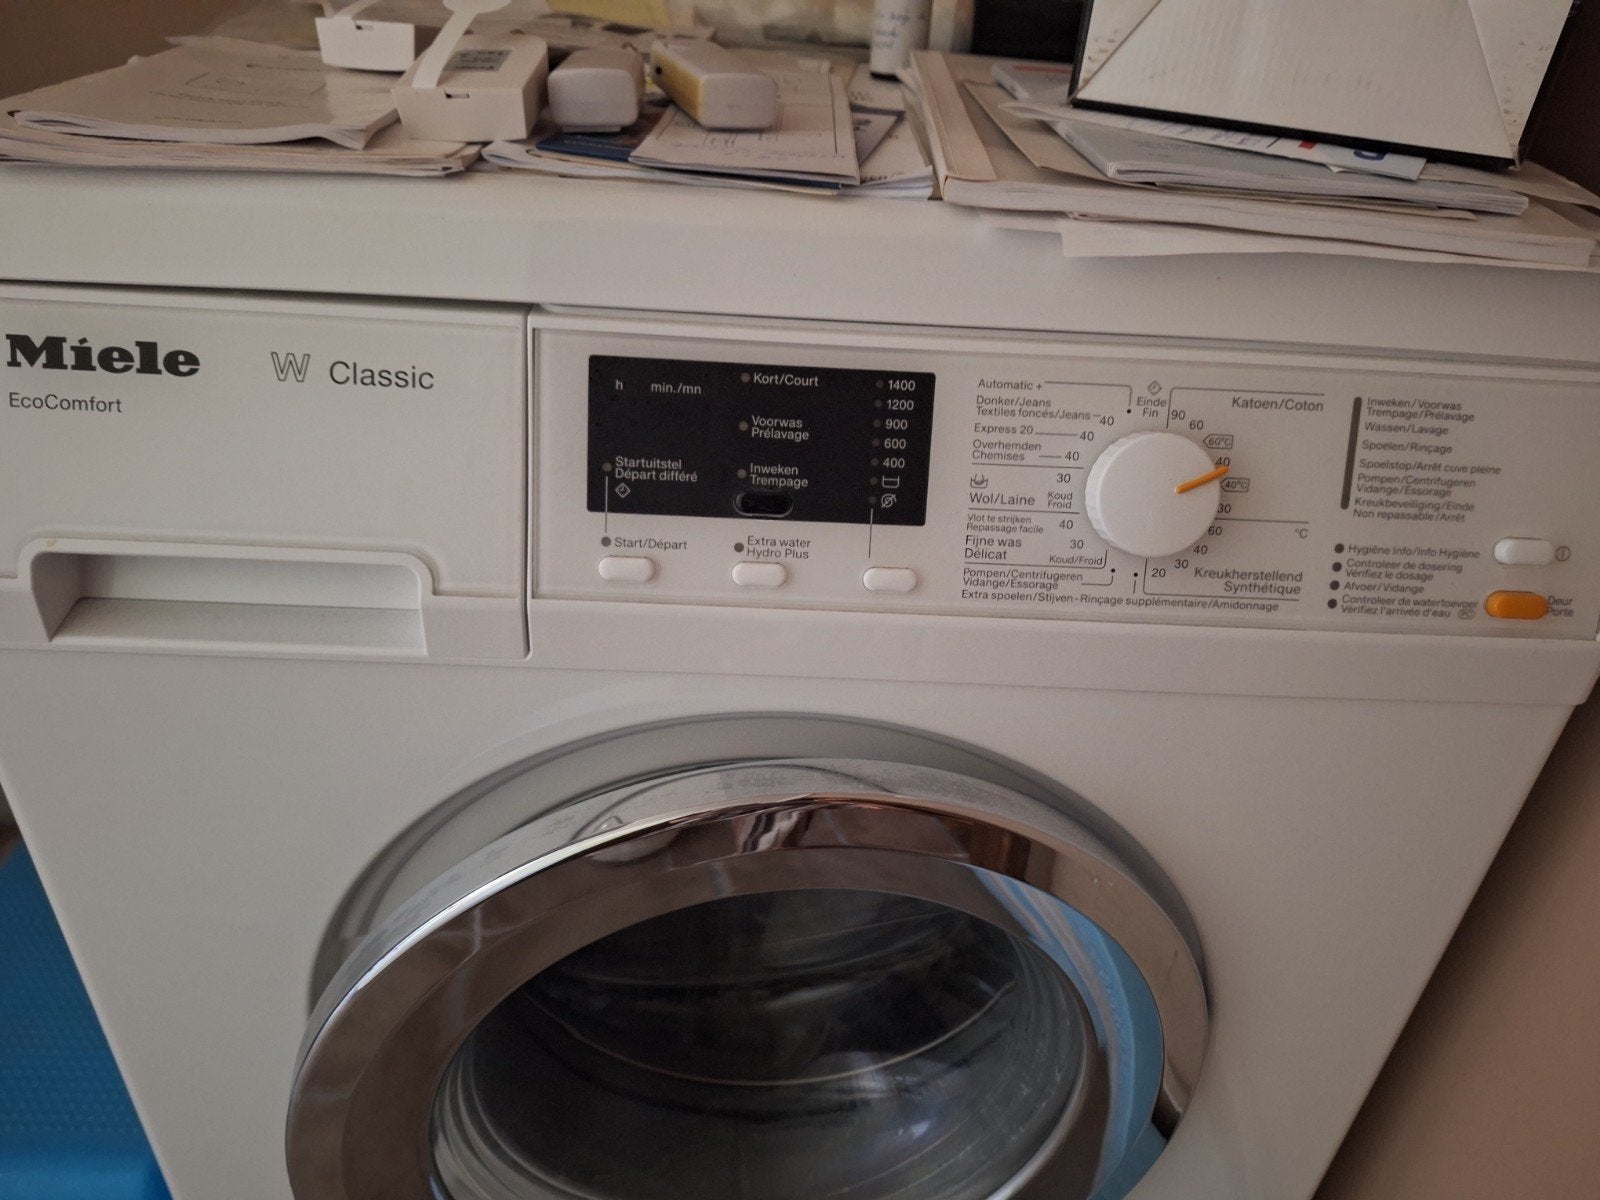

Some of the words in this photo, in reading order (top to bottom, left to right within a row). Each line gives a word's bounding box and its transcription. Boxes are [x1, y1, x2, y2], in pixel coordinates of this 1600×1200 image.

[6, 334, 200, 377] Miele
[271, 351, 311, 383] W
[329, 360, 434, 390] Classic
[615, 379, 624, 391] h
[753, 373, 819, 387] Kort/Court
[887, 379, 916, 392] 1400
[978, 379, 1033, 391] Automatic
[651, 383, 702, 395] min./mn
[9, 392, 122, 413] EcoComfort
[886, 399, 914, 411] 1200
[976, 395, 1052, 408] Donker/Jeans
[1136, 396, 1167, 408] Einde
[1231, 396, 1325, 413] Katoen/Coton
[1367, 397, 1463, 411] Inweken/Voorwas
[976, 406, 1016, 417] Textiles
[1018, 408, 1091, 421] foncés/Jeans
[1142, 407, 1159, 418] Fin
[1171, 409, 1186, 420] 90
[1367, 407, 1475, 423] Trempage/Prélavage
[751, 415, 803, 428] Voorwas
[885, 419, 908, 430] 900
[1099, 415, 1115, 427] 40
[1189, 420, 1204, 431] 60
[751, 427, 810, 443] Prélavage
[974, 423, 1017, 435] Express
[1020, 425, 1034, 435] 20
[1365, 421, 1449, 436] Wassen/Lavage
[1079, 431, 1095, 442] 40
[884, 438, 906, 450] 600
[972, 439, 1042, 452] Overhemden
[1362, 440, 1453, 455] Spoelen/Rinçage
[972, 450, 1025, 461] Chemises
[1064, 451, 1080, 462] 40
[1215, 456, 1231, 467] 40
[615, 456, 682, 470] Startuitstel
[750, 462, 799, 476] Inweken
[882, 457, 905, 469] 400
[1359, 459, 1442, 472] Spoelstop/Arrêt
[1444, 464, 1469, 473] cuve
[1470, 465, 1501, 476] pleine
[615, 468, 656, 482] Départ
[659, 471, 698, 483] différé
[751, 475, 809, 489] Trempage
[1056, 473, 1071, 484] 30
[1357, 473, 1476, 488] Pompen/Centrifugeren
[1047, 491, 1073, 501] Koud
[1356, 484, 1452, 498] Vidange/Essorage
[969, 492, 1036, 506] Wol/Laine
[1047, 500, 1072, 509] Froid
[1217, 503, 1231, 514] 30
[1353, 509, 1374, 518] Non
[967, 513, 985, 522] Vlot
[987, 514, 996, 522] te
[997, 515, 1032, 524] strijken
[1059, 519, 1074, 530] 40
[966, 523, 1017, 534] Repassage
[1019, 525, 1044, 534] facile
[1207, 525, 1222, 536] 60
[614, 537, 687, 551] Start/Départ
[747, 535, 777, 547] Extra
[780, 537, 811, 549] water
[964, 534, 995, 548] Fijne
[997, 538, 1022, 548] was
[1069, 539, 1084, 550] 30
[746, 547, 781, 561] Hydro
[784, 549, 809, 560] Plus
[964, 548, 1008, 561] Délicat
[1193, 545, 1208, 556] 40
[1049, 555, 1103, 566] Koud/Froid
[1174, 558, 1189, 569] 30
[1346, 558, 1401, 569] Controleer
[1403, 561, 1417, 570] de
[1418, 562, 1463, 574] dosering
[963, 567, 1084, 583] Pompen/Centrifugeren
[1151, 568, 1166, 578] 20
[1194, 567, 1303, 583] Kreukherstellend
[1384, 570, 1393, 579] le
[1395, 571, 1434, 583] dosage
[962, 577, 1059, 592] Vidange/Essorage
[1224, 581, 1302, 596] Synthétique
[961, 589, 989, 600] Extra
[991, 592, 1074, 604] spoelen/Stijven
[1080, 595, 1124, 607] Rinçage
[1125, 596, 1280, 613] supplémentaire/Amidonnage
[1398, 597, 1411, 606] de
